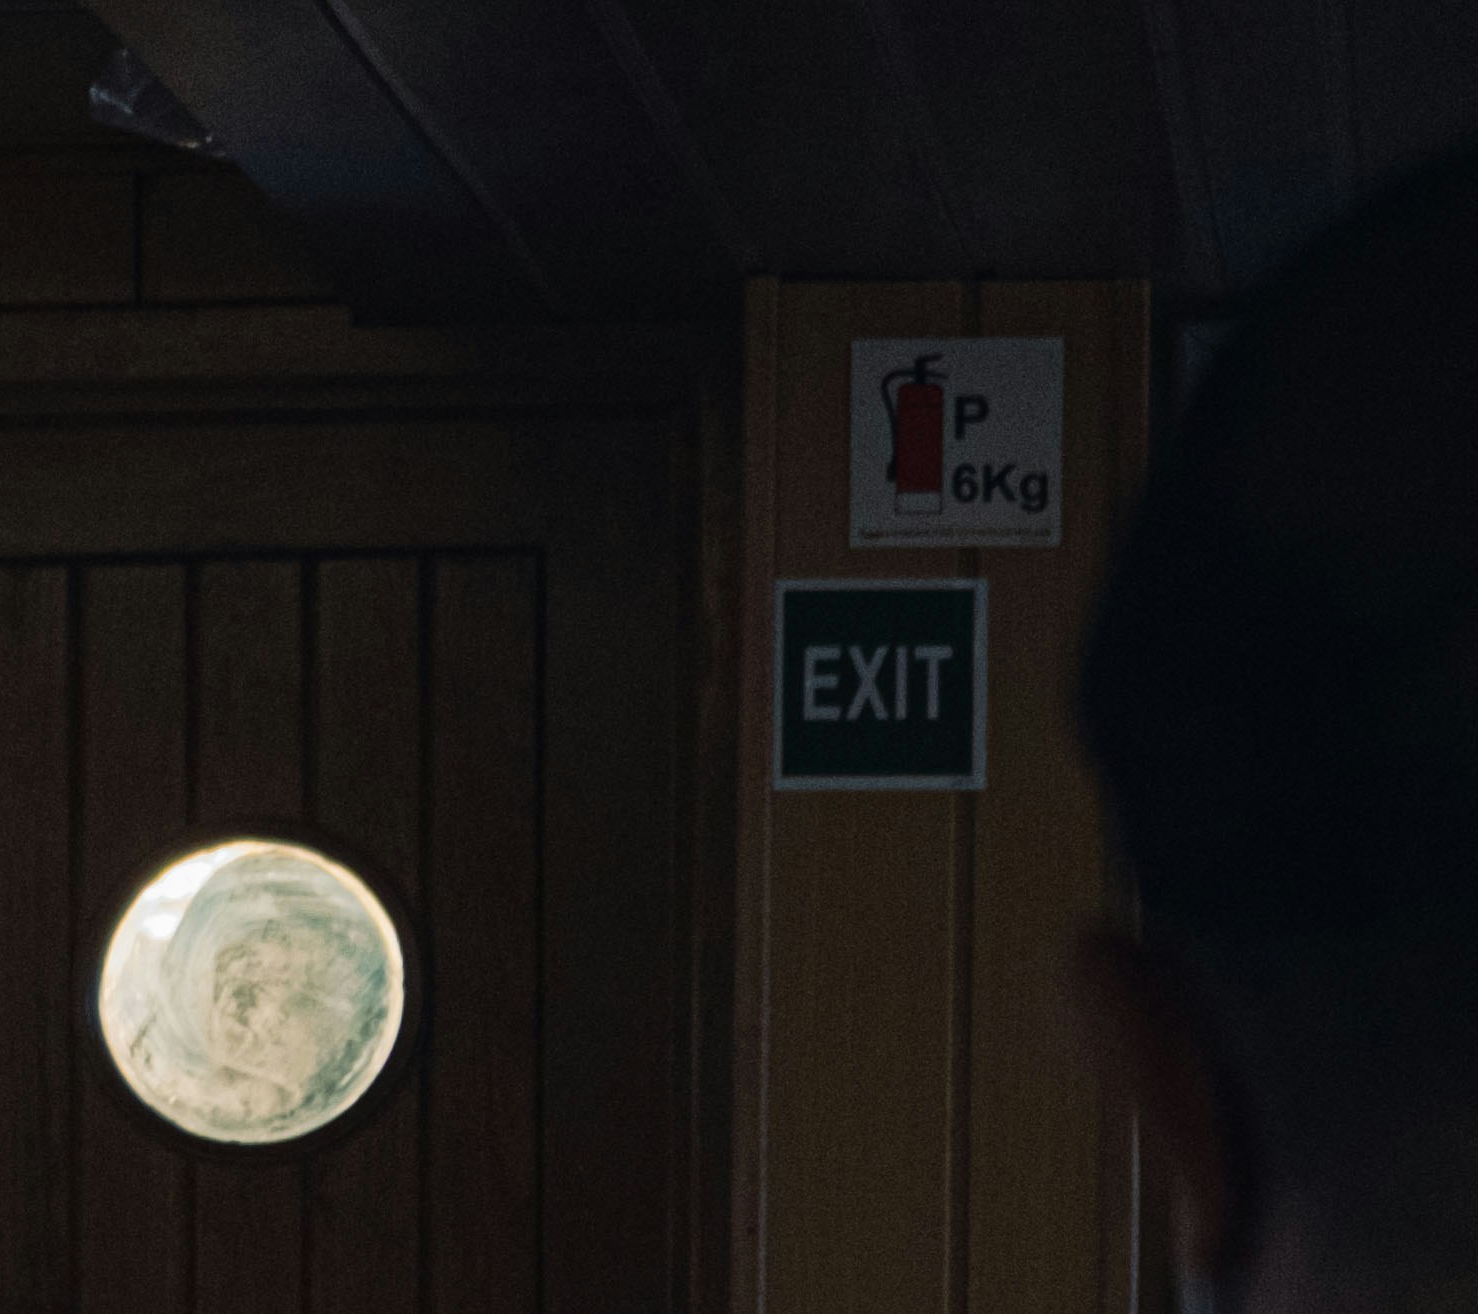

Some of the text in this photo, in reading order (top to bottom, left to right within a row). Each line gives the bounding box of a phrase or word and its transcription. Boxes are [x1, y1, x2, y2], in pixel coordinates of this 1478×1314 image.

[954, 394, 990, 440] P
[952, 462, 1050, 513] 6Kg
[802, 644, 954, 722] EXIT
